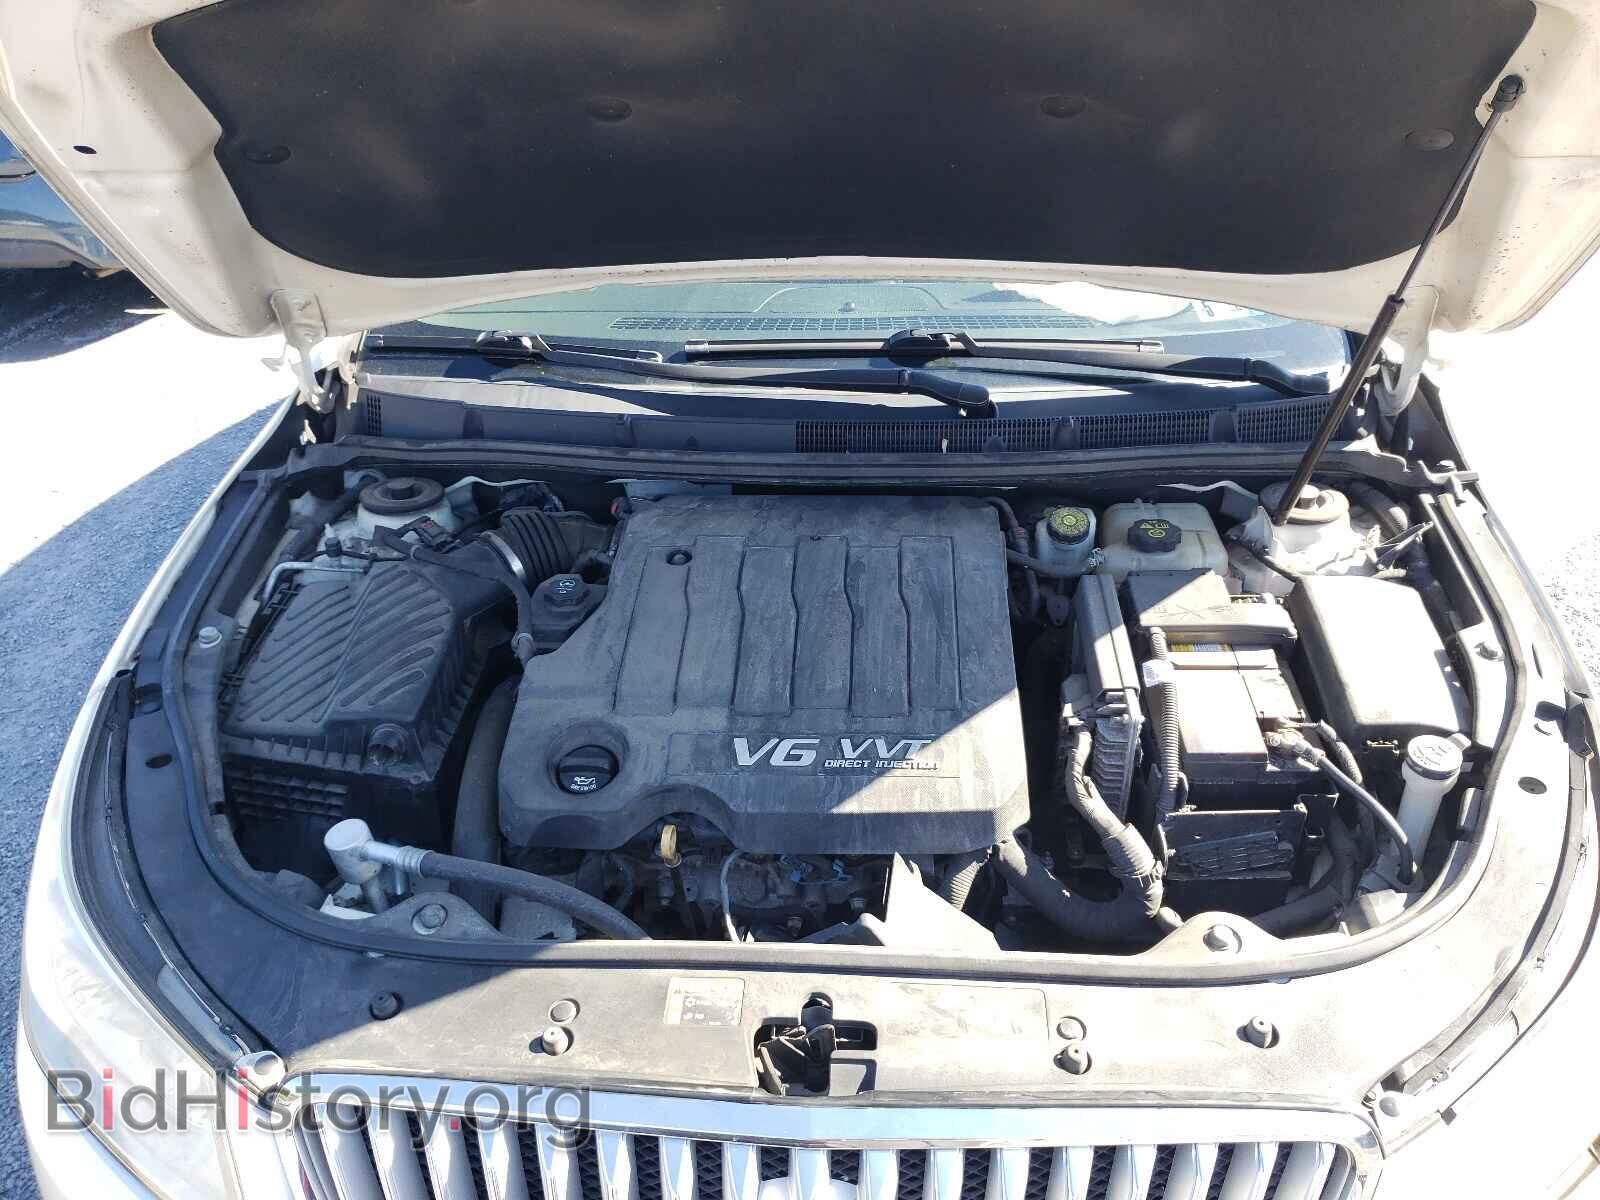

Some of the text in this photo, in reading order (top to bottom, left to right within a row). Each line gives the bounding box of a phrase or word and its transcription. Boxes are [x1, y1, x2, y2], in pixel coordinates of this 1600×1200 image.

[734, 738, 932, 766] V6 VVT
[824, 760, 938, 770] DIRECT INJECTION
